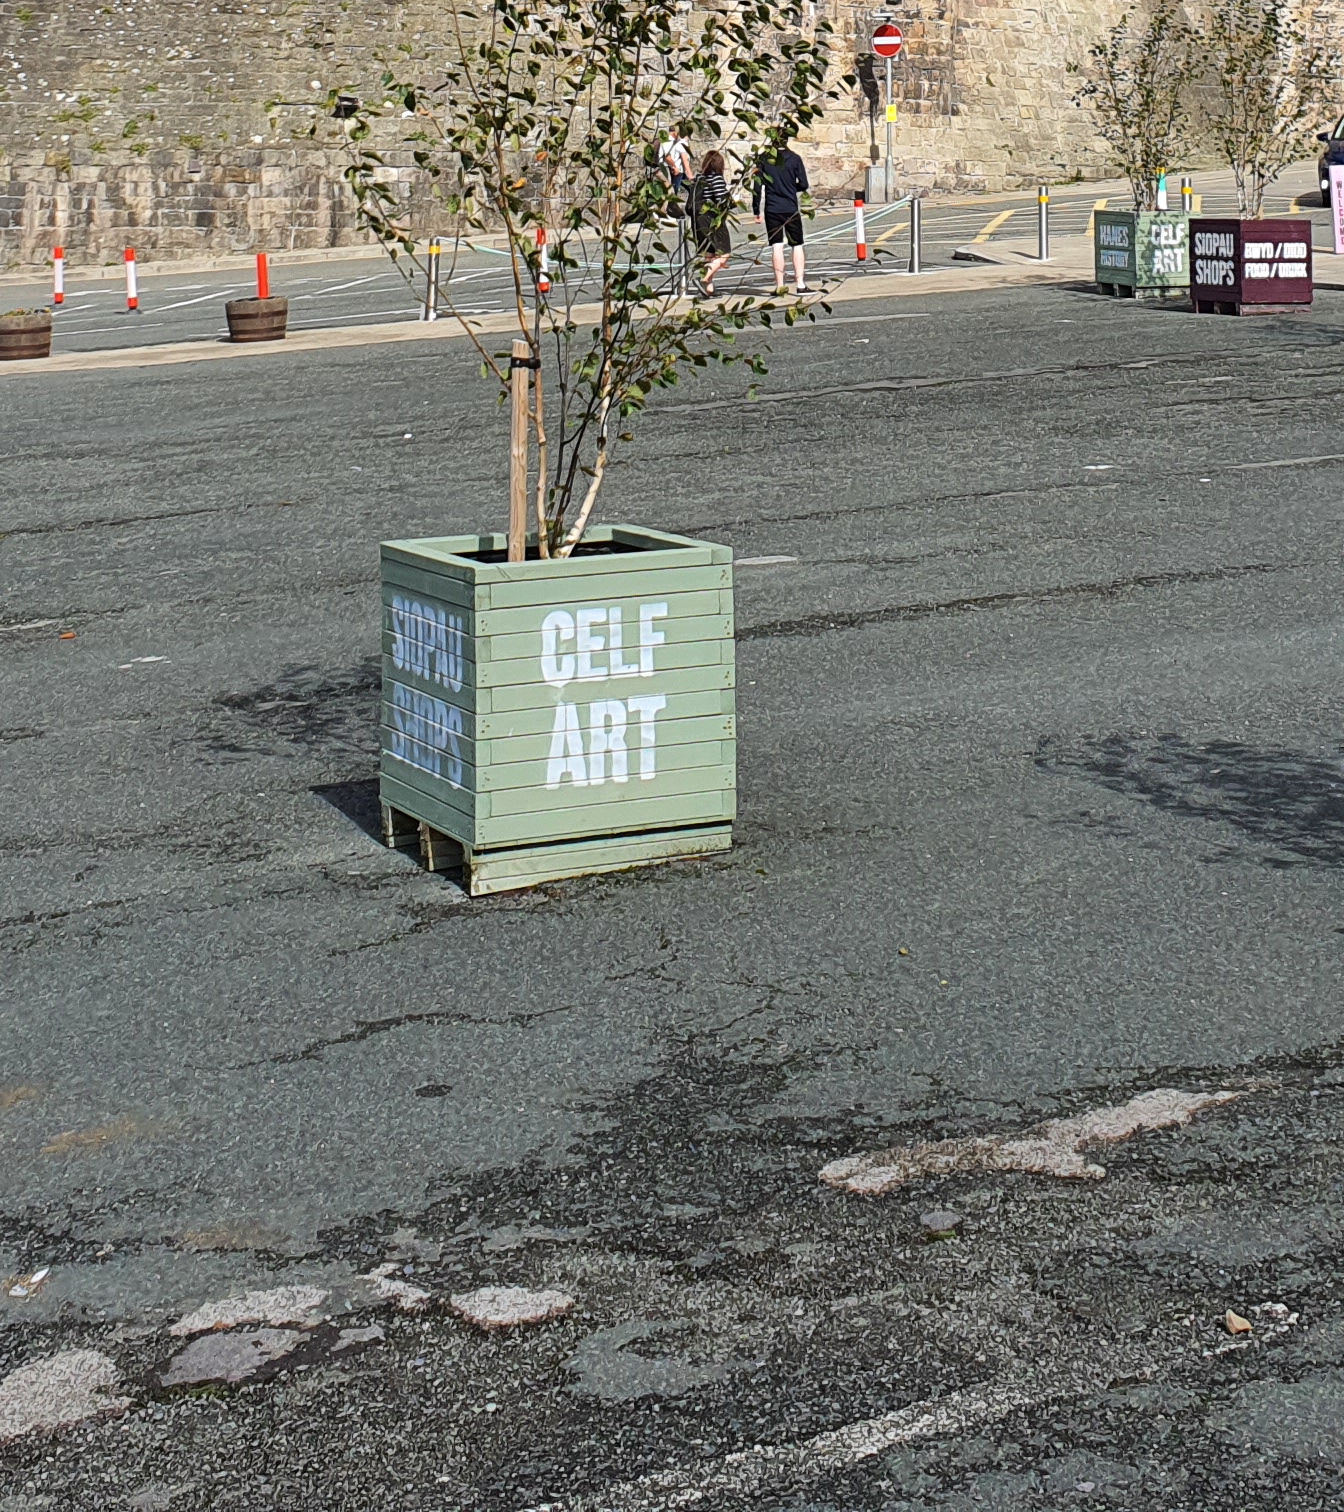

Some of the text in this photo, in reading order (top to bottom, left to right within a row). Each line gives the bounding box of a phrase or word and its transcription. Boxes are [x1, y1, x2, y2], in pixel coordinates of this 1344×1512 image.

[1151, 223, 1185, 245] CELF
[1336, 180, 1344, 245] WELCOME
[1099, 224, 1129, 248] HANES
[1194, 232, 1234, 257] SIOPAU
[1153, 248, 1185, 275] ART
[1195, 259, 1235, 286] SHOPS
[391, 595, 463, 693] SIOPAU
[540, 602, 668, 688] CELF
[391, 684, 463, 789] SHOPS
[546, 694, 667, 790] ART
